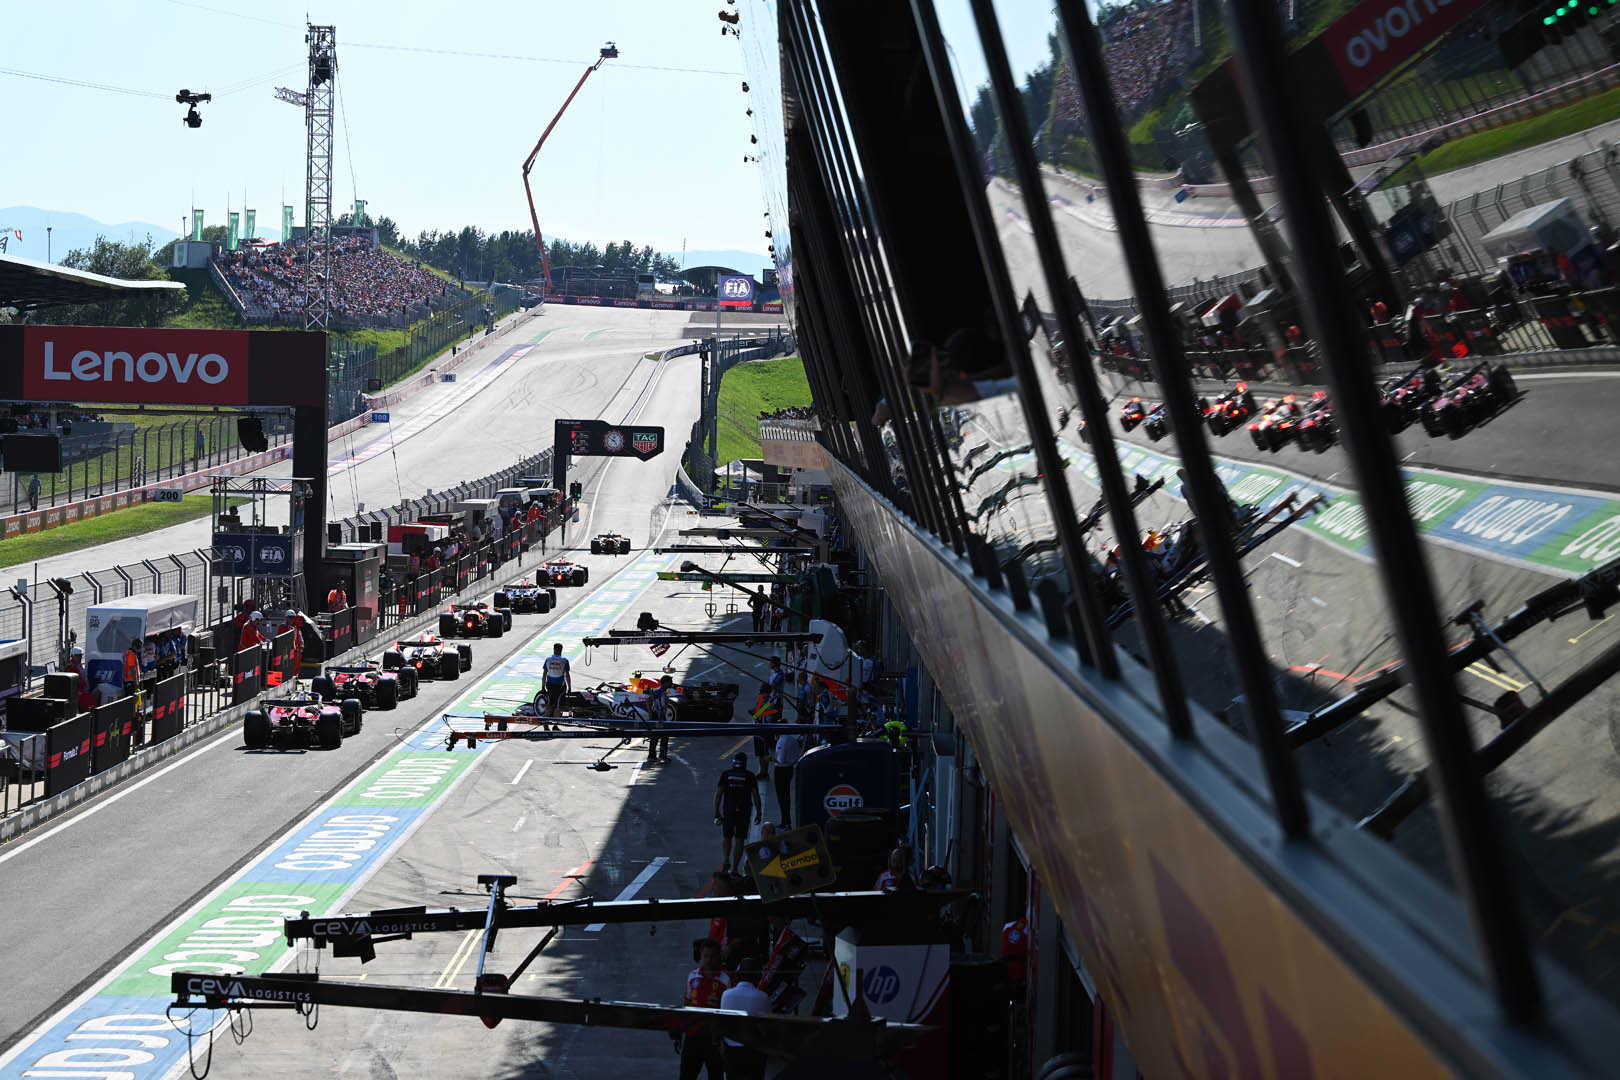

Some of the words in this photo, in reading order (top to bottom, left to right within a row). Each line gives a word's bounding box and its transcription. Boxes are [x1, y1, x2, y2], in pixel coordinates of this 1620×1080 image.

[725, 281, 747, 294] FIA
[44, 341, 229, 384] Lenovo
[634, 442, 657, 453] HEUER
[160, 491, 178, 500] 200
[608, 701, 636, 719] VISA
[826, 797, 862, 808] Gulf
[274, 814, 400, 871] aramco
[780, 854, 817, 870] brembo
[375, 922, 437, 933] LOGISTICS
[148, 895, 316, 976] aramco
[868, 967, 897, 1004] hp
[249, 989, 311, 1001] LOGISTICS
